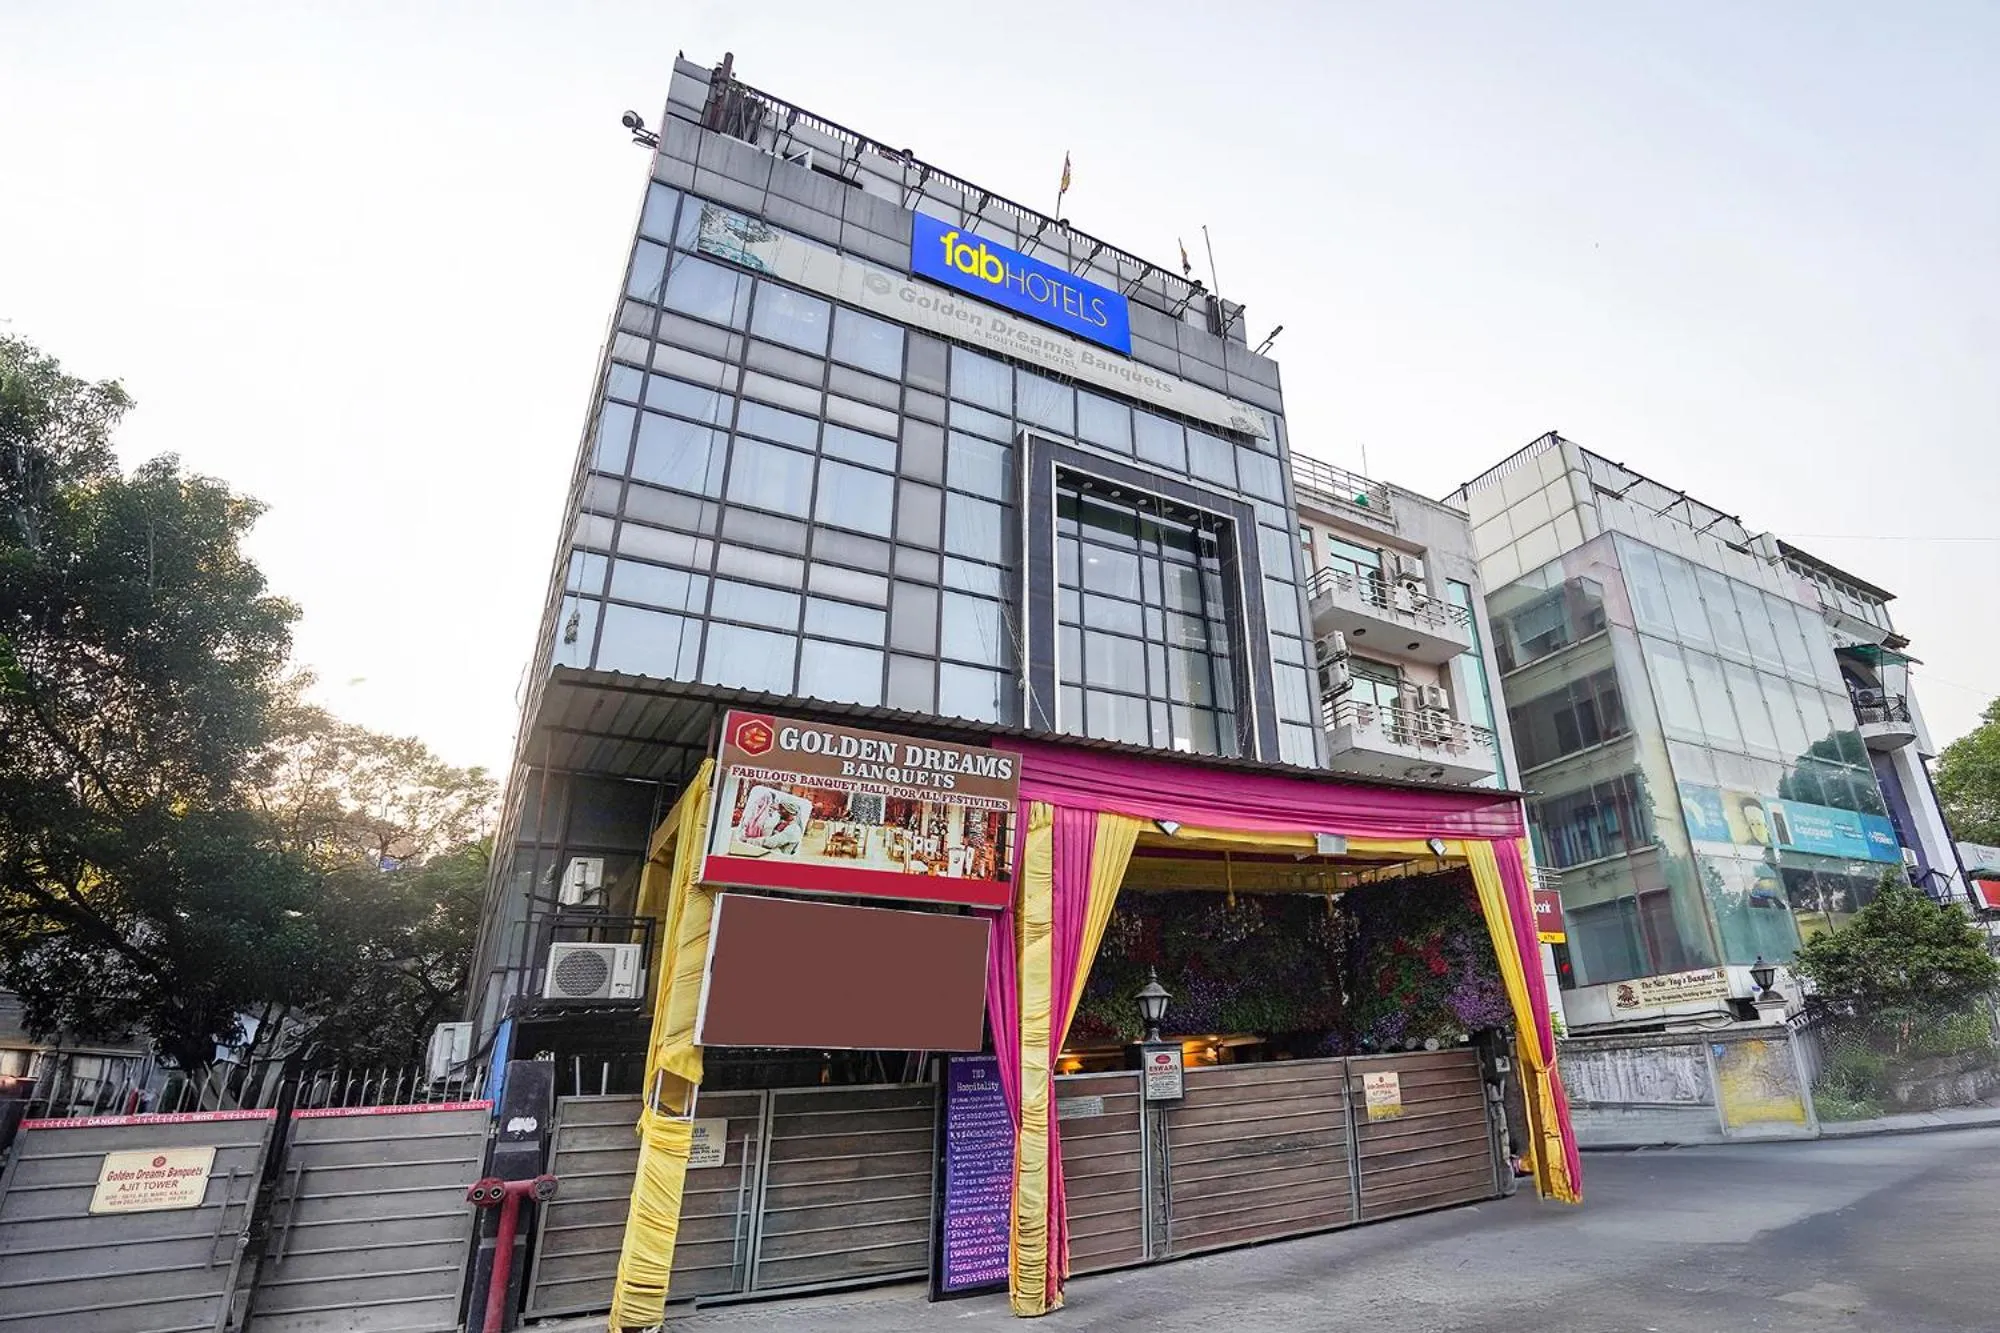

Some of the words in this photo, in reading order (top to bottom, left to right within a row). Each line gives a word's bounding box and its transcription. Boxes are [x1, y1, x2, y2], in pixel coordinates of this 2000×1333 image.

[899, 287, 983, 326] Golden
[991, 318, 1075, 359] Dreams
[1081, 350, 1173, 393] Banquets
[974, 327, 981, 337] A
[985, 331, 1040, 357] BOUTIQUE
[1044, 352, 1078, 371] HOTEL
[780, 727, 898, 765] GOLDEN
[904, 744, 1013, 780] DREAMS
[732, 766, 797, 784] FABULOUS
[800, 775, 858, 791] BANQUET
[861, 783, 889, 795] HALL
[893, 788, 917, 799] FOR
[919, 791, 940, 801] ALL
[942, 794, 1009, 810] FESTIVITIES
[841, 759, 956, 789] BANQUETS
[957, 1081, 999, 1093] Hospitality
[88, 1116, 127, 1126] DANGER
[107, 1170, 135, 1182] Golden
[136, 1168, 165, 1180] Dreams
[168, 1166, 204, 1179] Banquets
[118, 1183, 140, 1192] AJIT
[144, 1180, 179, 1190] TOWER
